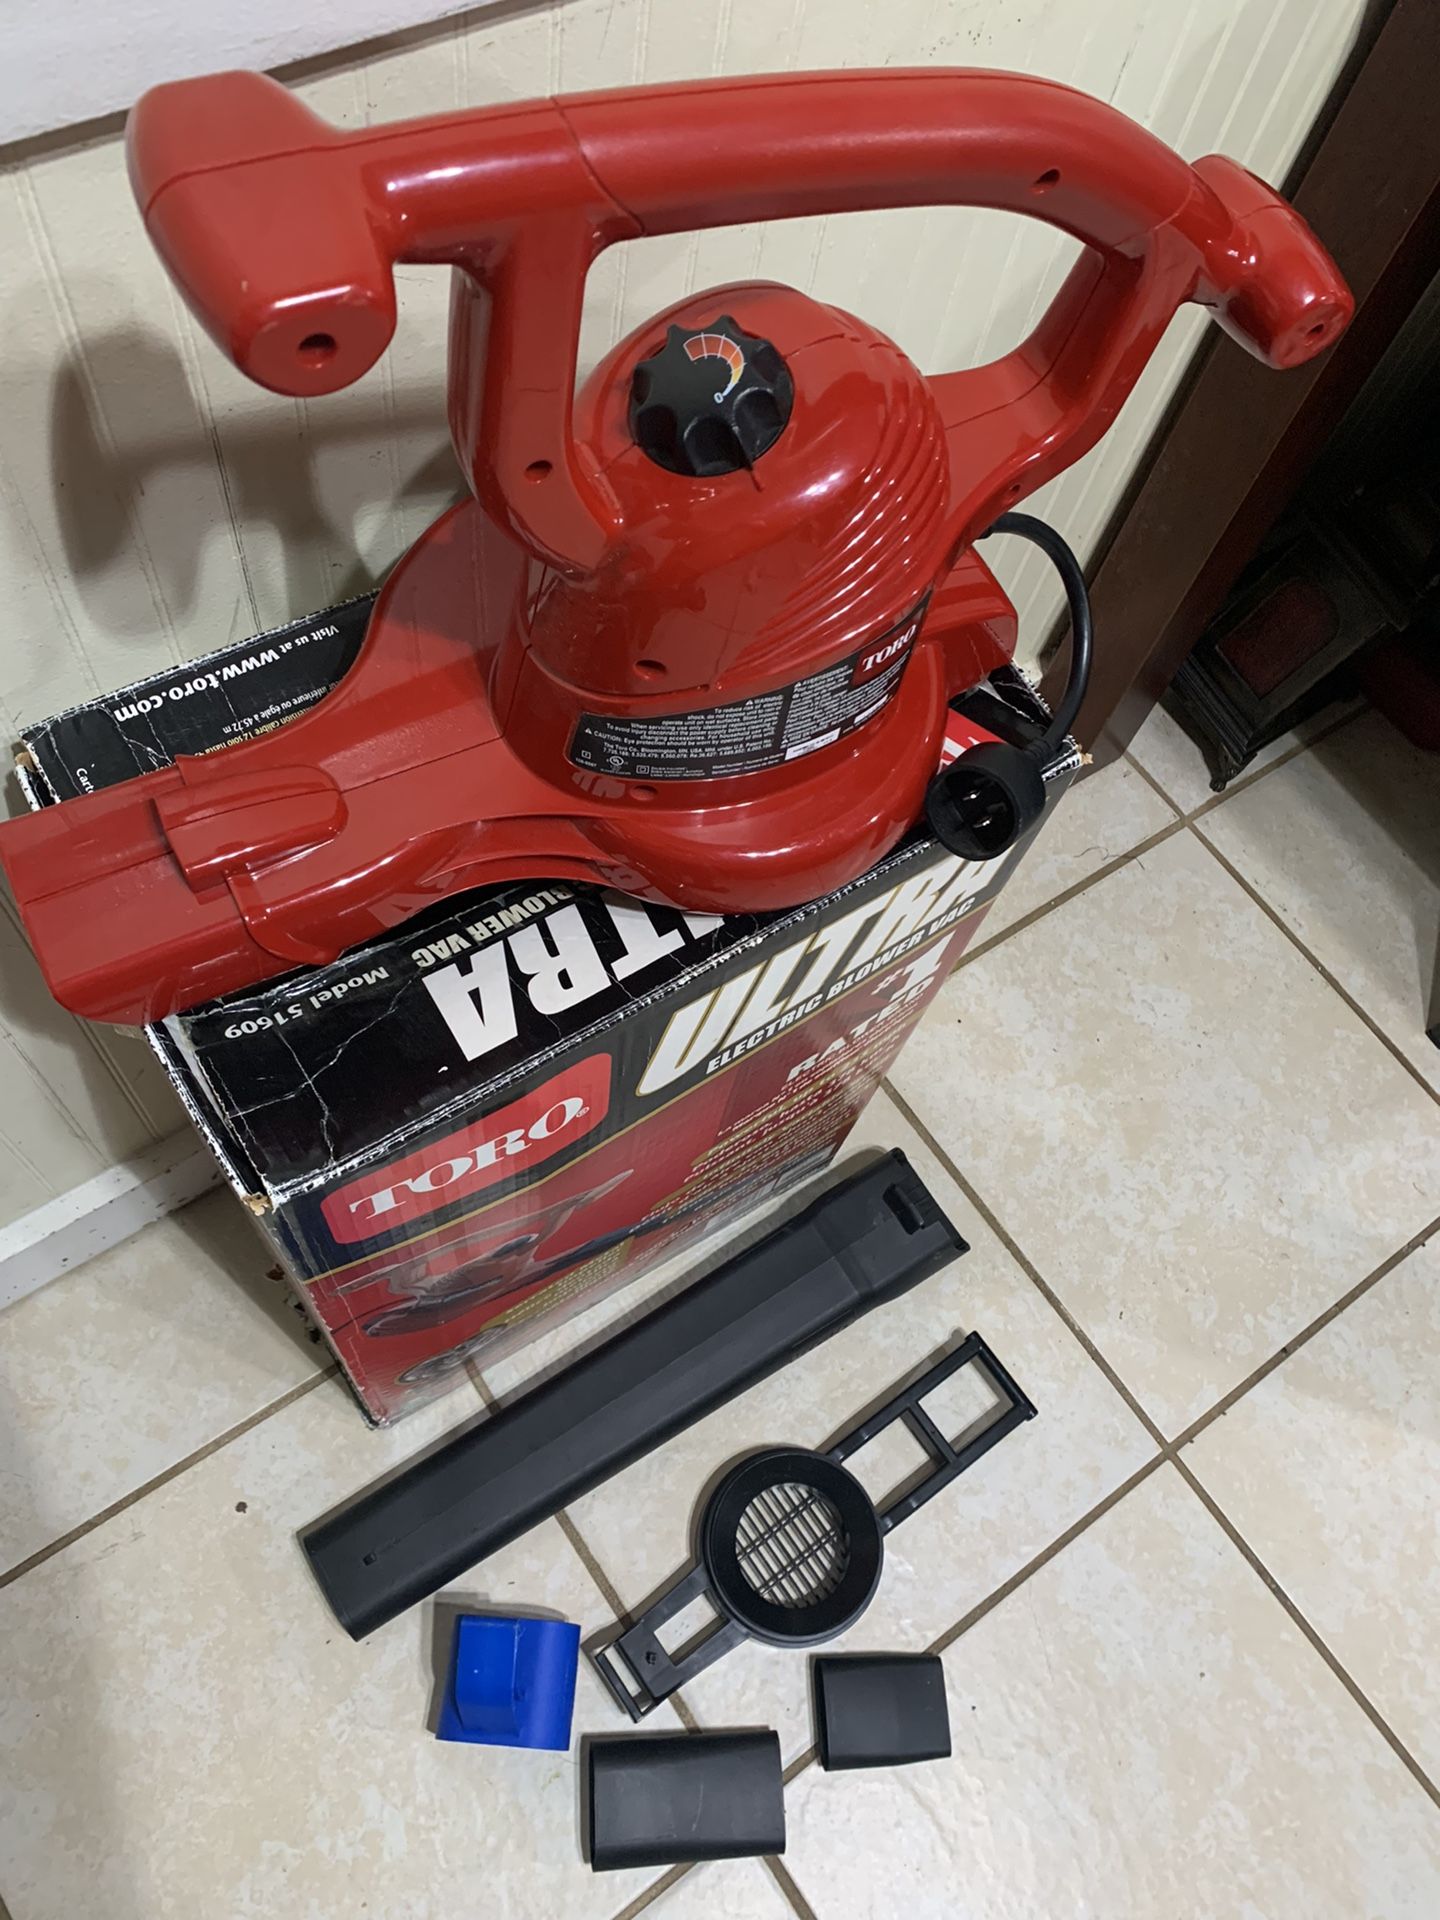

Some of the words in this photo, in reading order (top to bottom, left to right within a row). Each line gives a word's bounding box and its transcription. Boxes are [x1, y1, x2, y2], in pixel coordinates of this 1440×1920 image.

[281, 641, 293, 655] at
[294, 634, 309, 648] us
[310, 625, 339, 642] Visit
[862, 624, 917, 672] TORO
[113, 648, 280, 723] www.toro.com
[281, 700, 292, 712] ou
[259, 705, 281, 720] égale
[466, 884, 576, 944] BLOWER
[410, 923, 473, 969] VAC
[636, 842, 1017, 1097] ULTRA
[313, 965, 389, 1010] Model
[421, 893, 726, 1062] TRA
[706, 997, 821, 1074] ELECTRIC
[826, 931, 922, 999] BLOWER
[928, 897, 976, 945] VAC
[224, 1005, 303, 1041] 51609
[787, 975, 935, 1082] RATED
[349, 1096, 585, 1221] TORO
